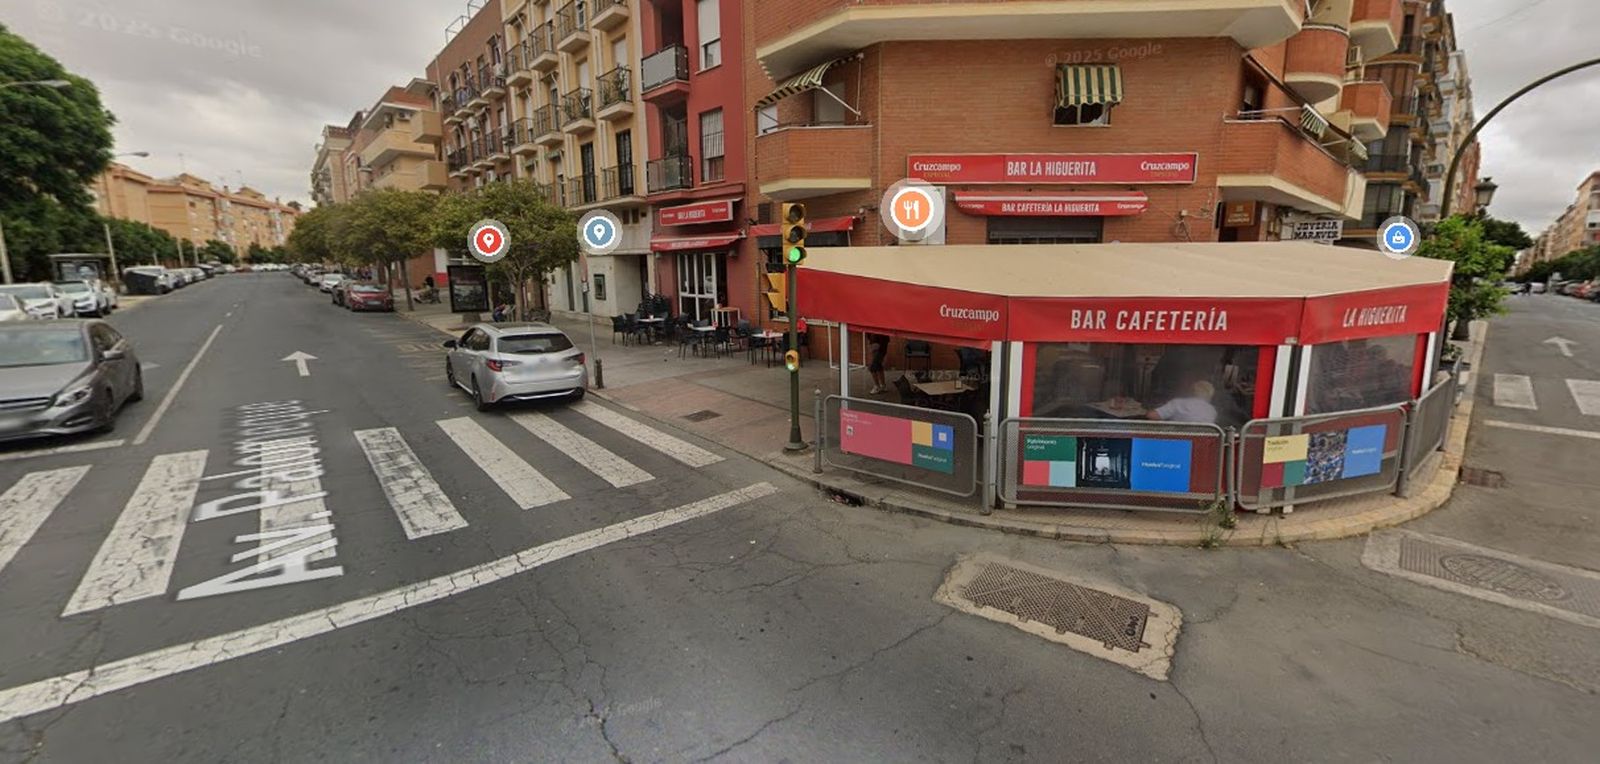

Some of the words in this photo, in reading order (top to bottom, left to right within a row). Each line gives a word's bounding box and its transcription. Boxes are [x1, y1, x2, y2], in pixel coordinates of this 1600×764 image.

[913, 161, 961, 172] Cruzcampo
[1007, 161, 1026, 176] BAR
[1029, 161, 1042, 176] LA
[1045, 161, 1097, 176] HIGUERITA
[1140, 161, 1190, 171] Cruzcampo
[1001, 203, 1015, 213] BAR
[1054, 203, 1063, 213] LA
[1064, 203, 1099, 213] HIGUERITA
[940, 304, 999, 322] Cruzcampo
[1070, 309, 1107, 329] BAR
[1115, 307, 1228, 331] CAFETERÍA
[1343, 308, 1358, 328] LA
[1358, 305, 1408, 326] HIGUERITA
